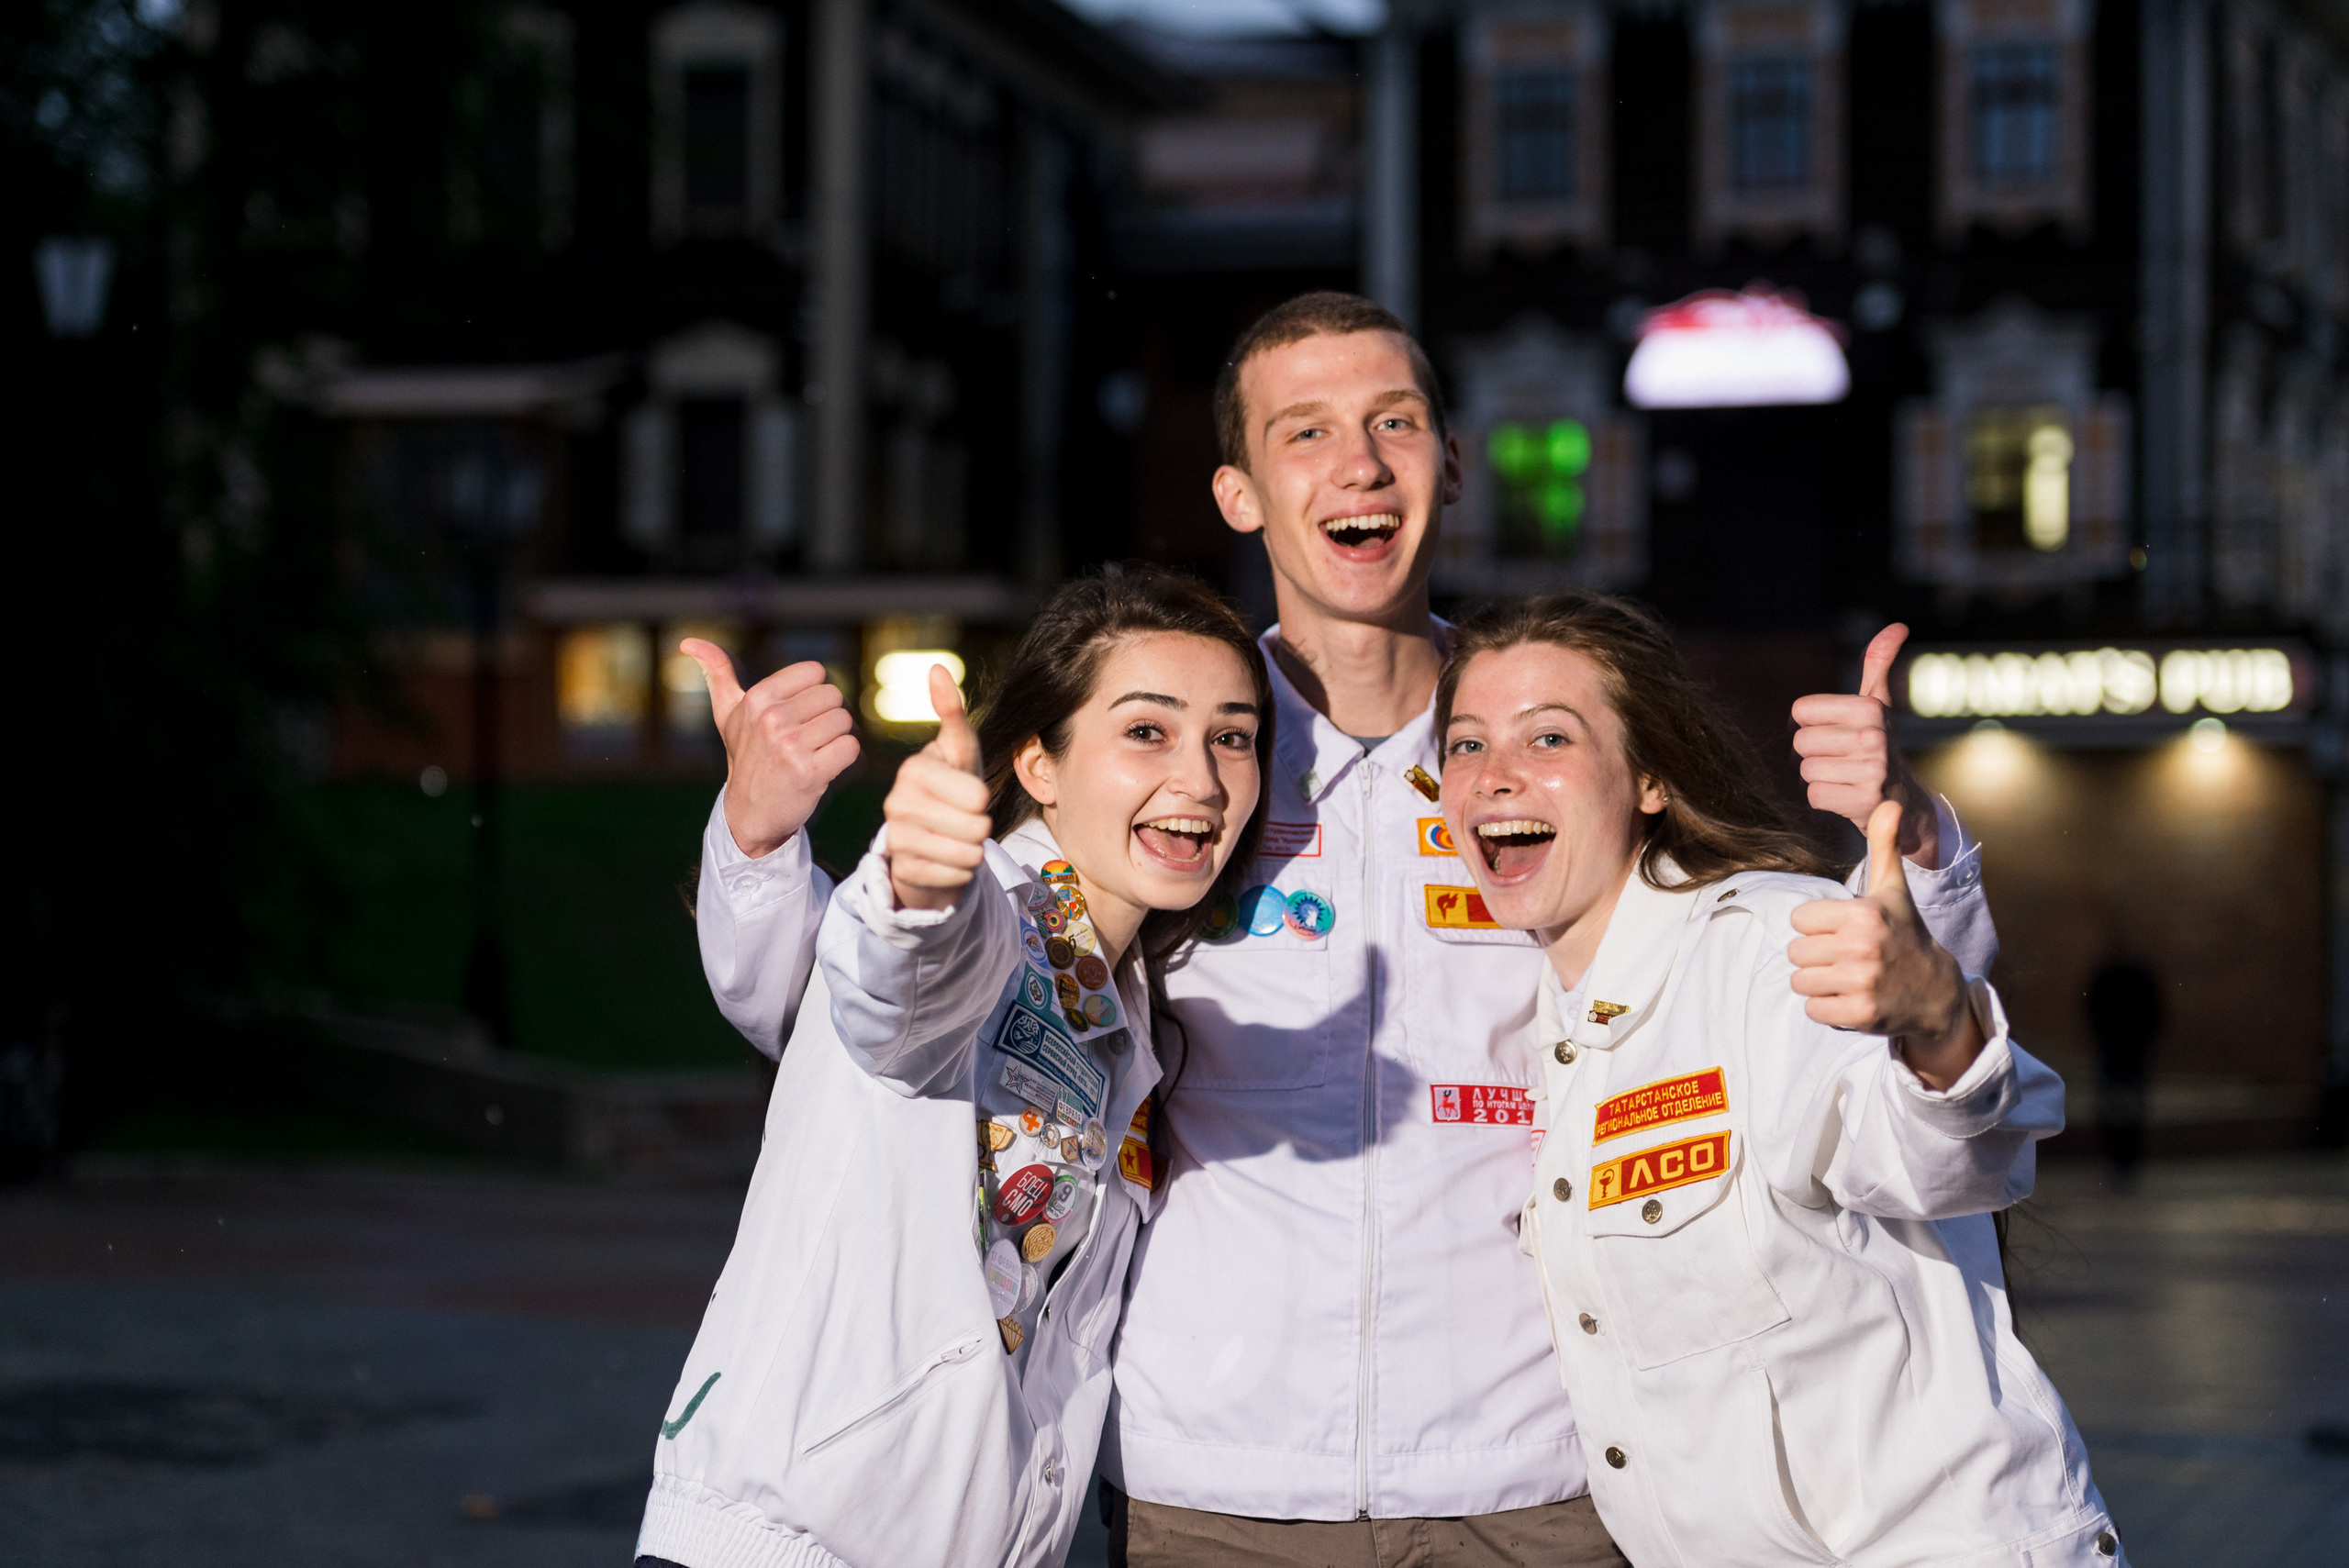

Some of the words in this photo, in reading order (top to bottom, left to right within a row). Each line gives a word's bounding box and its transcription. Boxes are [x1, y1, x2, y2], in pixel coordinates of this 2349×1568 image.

[1059, 1086, 1069, 1103] 17
[1473, 1086, 1523, 1102] ЛУЧШ
[1473, 1098, 1485, 1109] ПО
[1486, 1099, 1517, 1110] ИТОГАМ
[1609, 1080, 1700, 1117] ТАТАРСТАНСКОЕ
[1058, 1102, 1082, 1123] ФЕВРАЛЯ
[1597, 1107, 1660, 1138] РЕГИОНАЛЬНОЕ
[1661, 1091, 1723, 1118] ОТДЕЛЕНИЕ
[1017, 1171, 1049, 1202] БОЕЦ
[1002, 1188, 1034, 1218] СМО
[991, 1250, 997, 1264] 17
